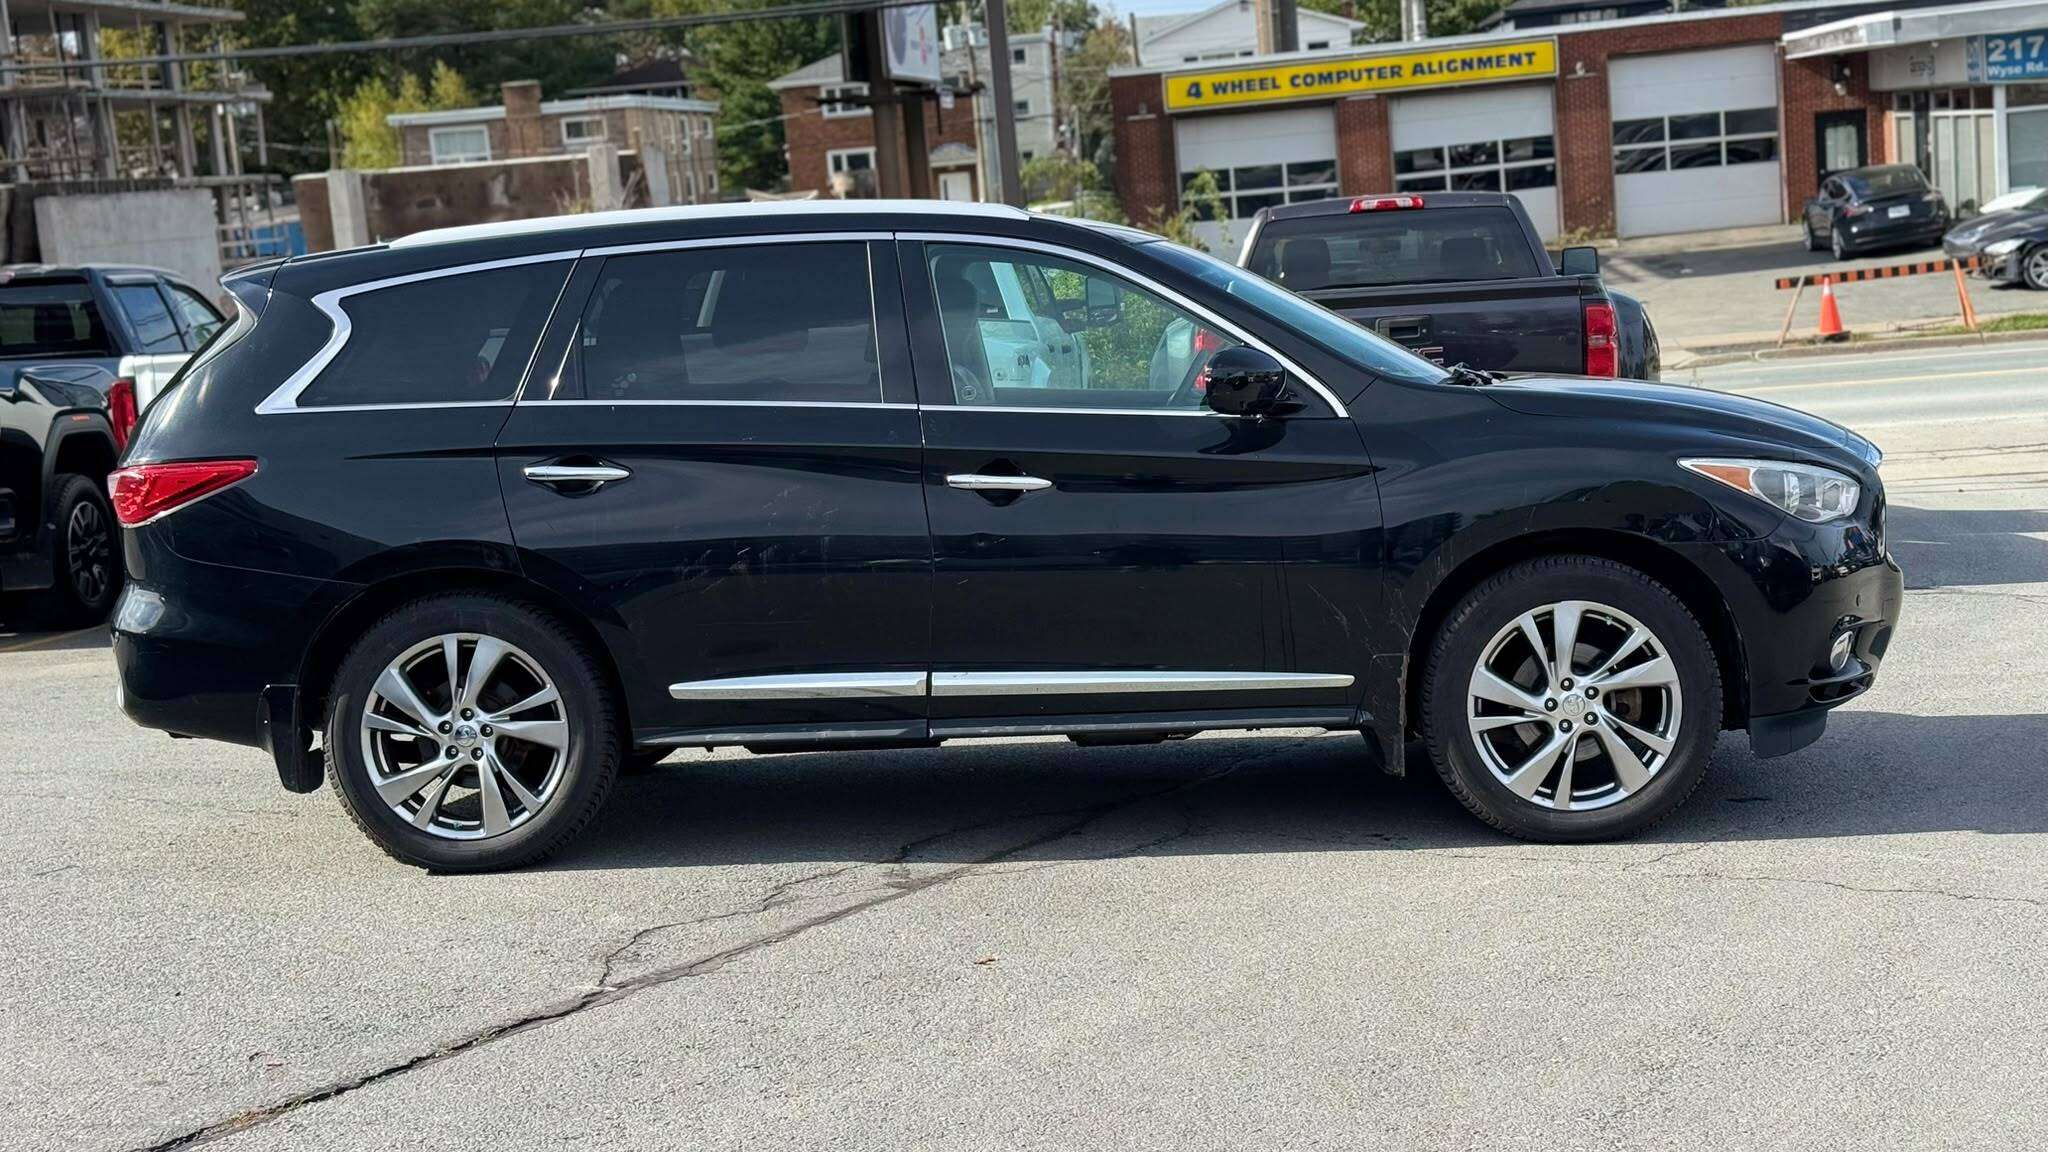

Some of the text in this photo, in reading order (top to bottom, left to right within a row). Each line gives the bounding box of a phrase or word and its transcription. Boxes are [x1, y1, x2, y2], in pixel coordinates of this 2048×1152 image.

[1988, 36, 2045, 62] 217
[1186, 52, 1536, 99] 4 WHEEL COMPUTER ALIGNMENT
[1987, 64, 2023, 78] Wyse
